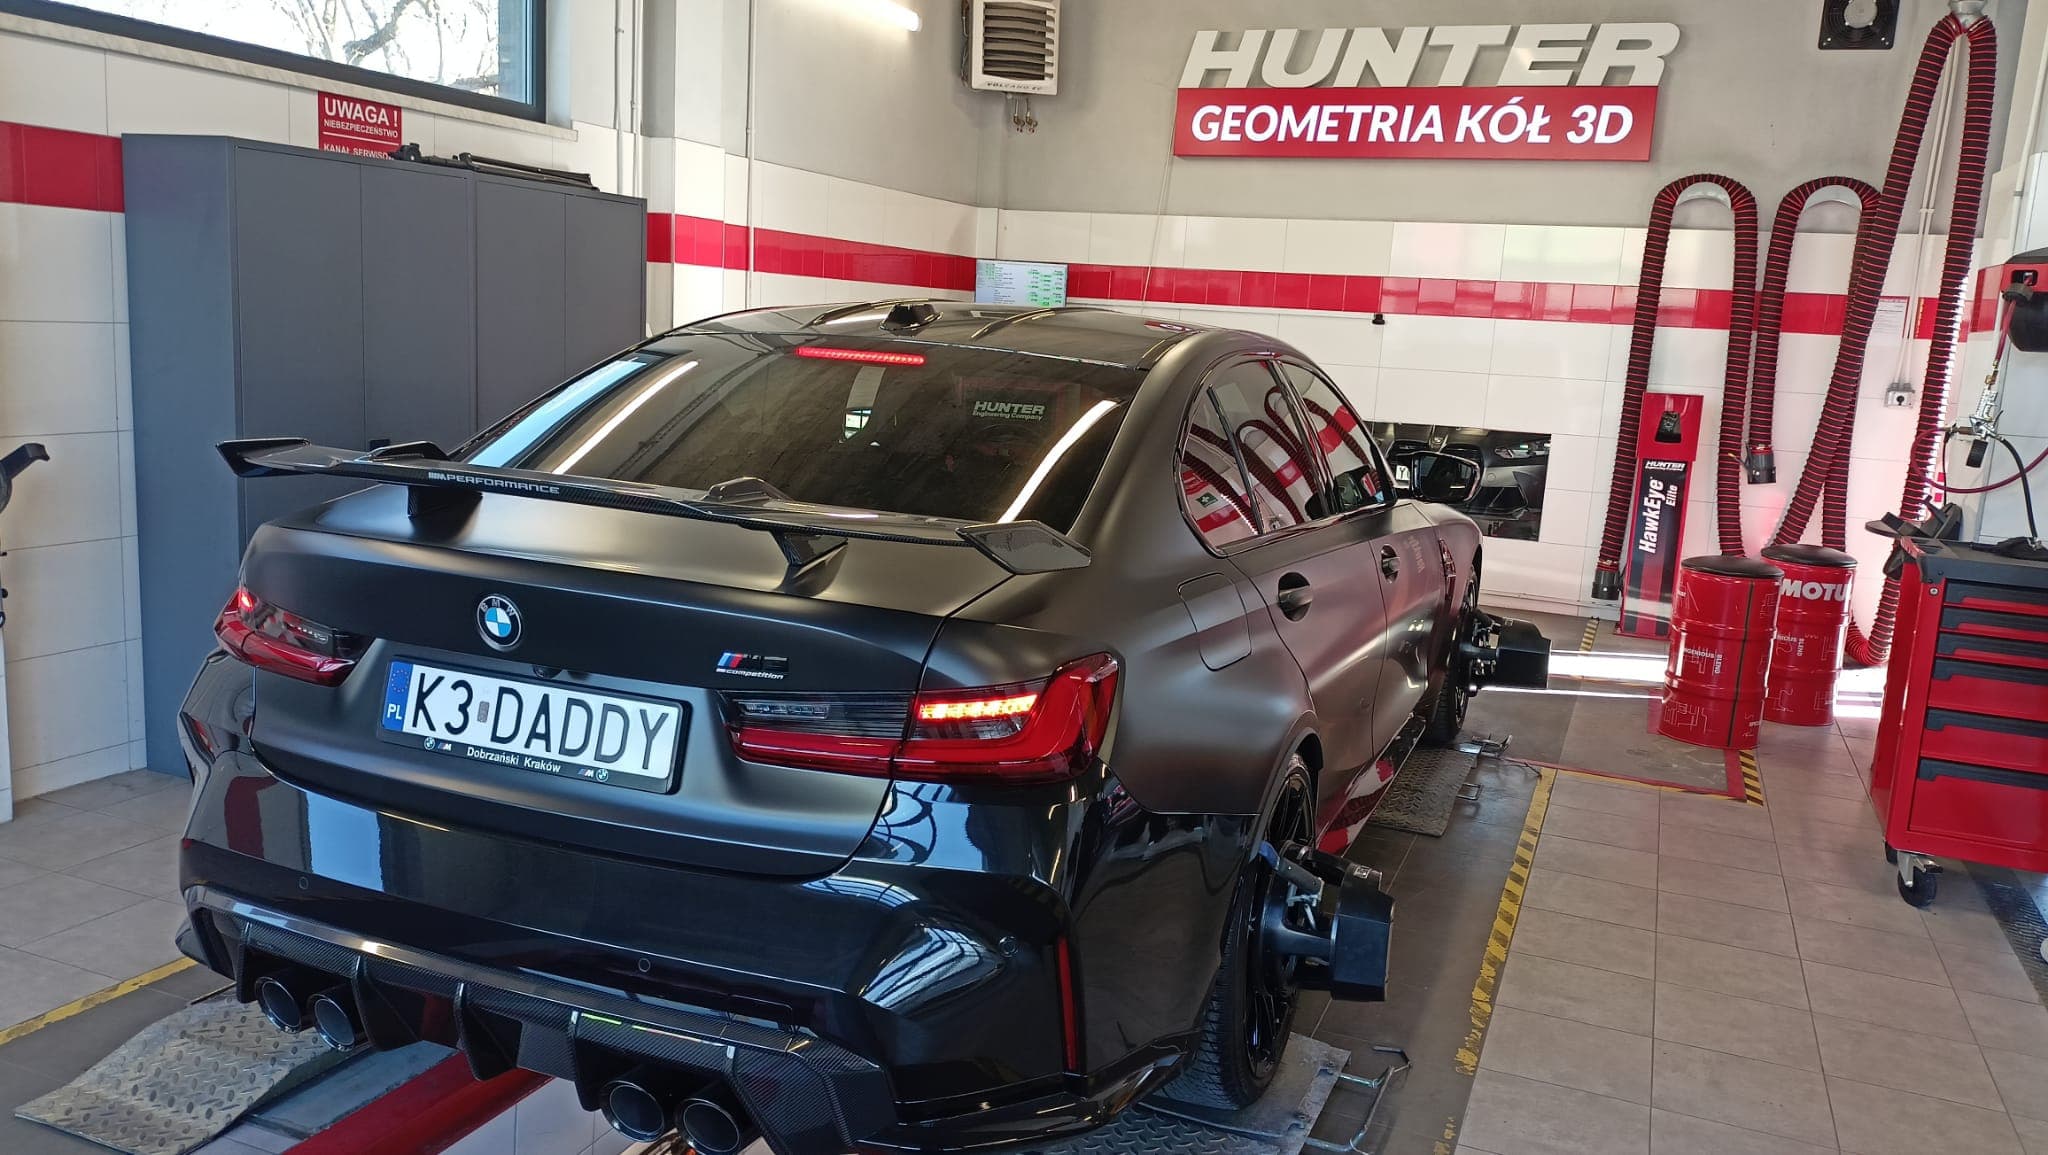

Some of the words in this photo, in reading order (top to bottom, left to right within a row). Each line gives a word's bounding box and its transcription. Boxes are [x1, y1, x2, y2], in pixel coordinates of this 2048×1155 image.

[1178, 22, 1680, 88] HUNTER
[324, 97, 390, 127] UWAGA
[1192, 103, 1444, 143] GEOMETRIA
[1455, 96, 1551, 144] KÓŁ
[1566, 104, 1634, 144] 3D
[324, 118, 399, 138] NIEBEZPIECZEŃSTWO
[353, 147, 394, 160] SERWISO
[972, 409, 1010, 419] Engineering
[1011, 412, 1043, 421] Company
[974, 400, 1045, 415] HUNTER
[1645, 460, 1686, 471] HUNTER
[1665, 484, 1678, 507] Elite
[1639, 479, 1666, 554] HawkEye
[1780, 578, 1852, 601] MOTU
[726, 669, 784, 680] competition
[387, 703, 402, 721] PL
[412, 672, 474, 736] K3
[490, 686, 669, 770] DADDY
[466, 746, 519, 766] Dobrzański
[523, 757, 561, 773] Kraków
